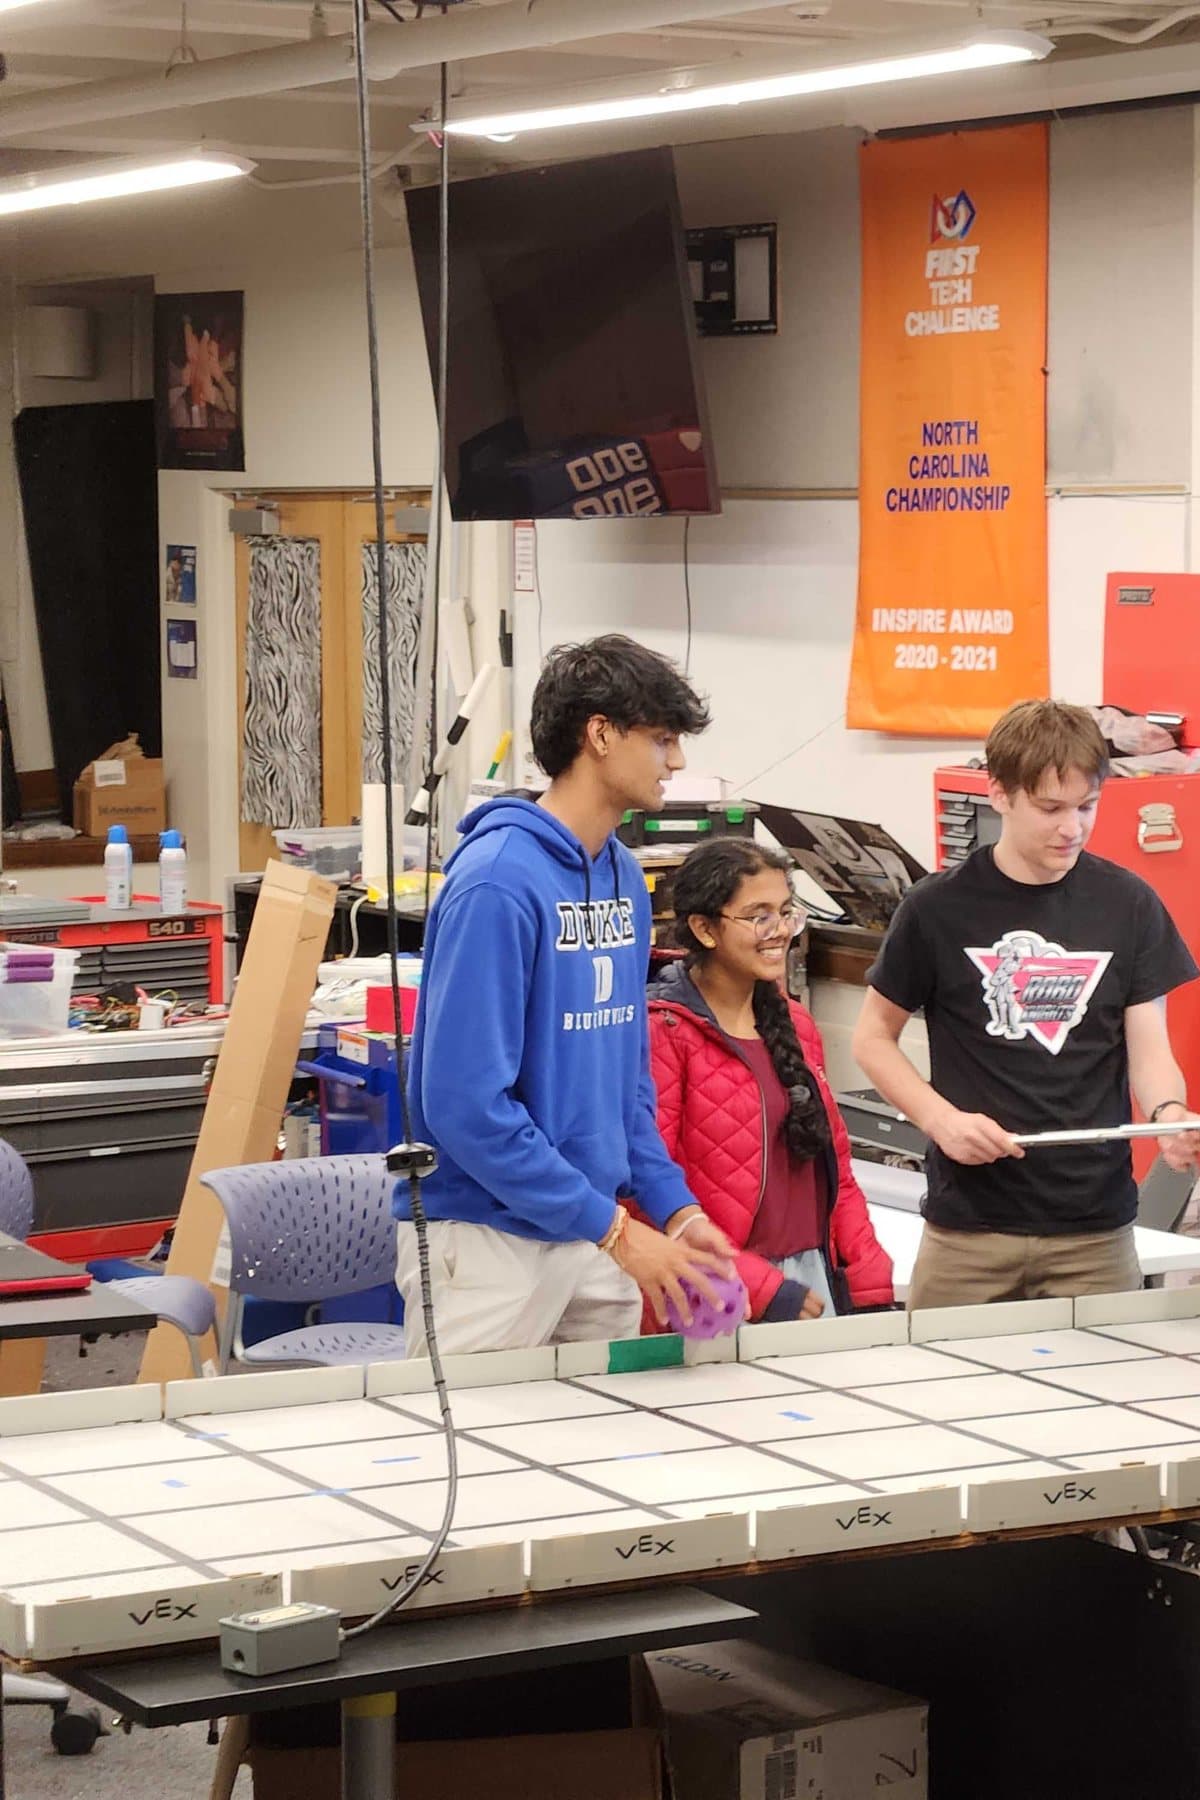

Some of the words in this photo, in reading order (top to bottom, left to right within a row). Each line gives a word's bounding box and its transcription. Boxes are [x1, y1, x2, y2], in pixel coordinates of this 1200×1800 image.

[925, 246, 980, 279] FIRST
[929, 278, 973, 305] TECH
[905, 304, 999, 336] CHALLENGE
[922, 420, 978, 447] NORTH
[909, 453, 990, 479] CAROLINA
[886, 486, 1010, 512] CHAMPIONSHIP
[872, 608, 946, 633] INSPIRE
[949, 609, 1014, 635] AWARD
[894, 644, 938, 669] 2020
[951, 645, 997, 671] 2021
[150, 920, 185, 936] 540
[555, 898, 636, 951] DUKE
[592, 955, 614, 1004] D
[656, 1654, 737, 1682] GILDAN
